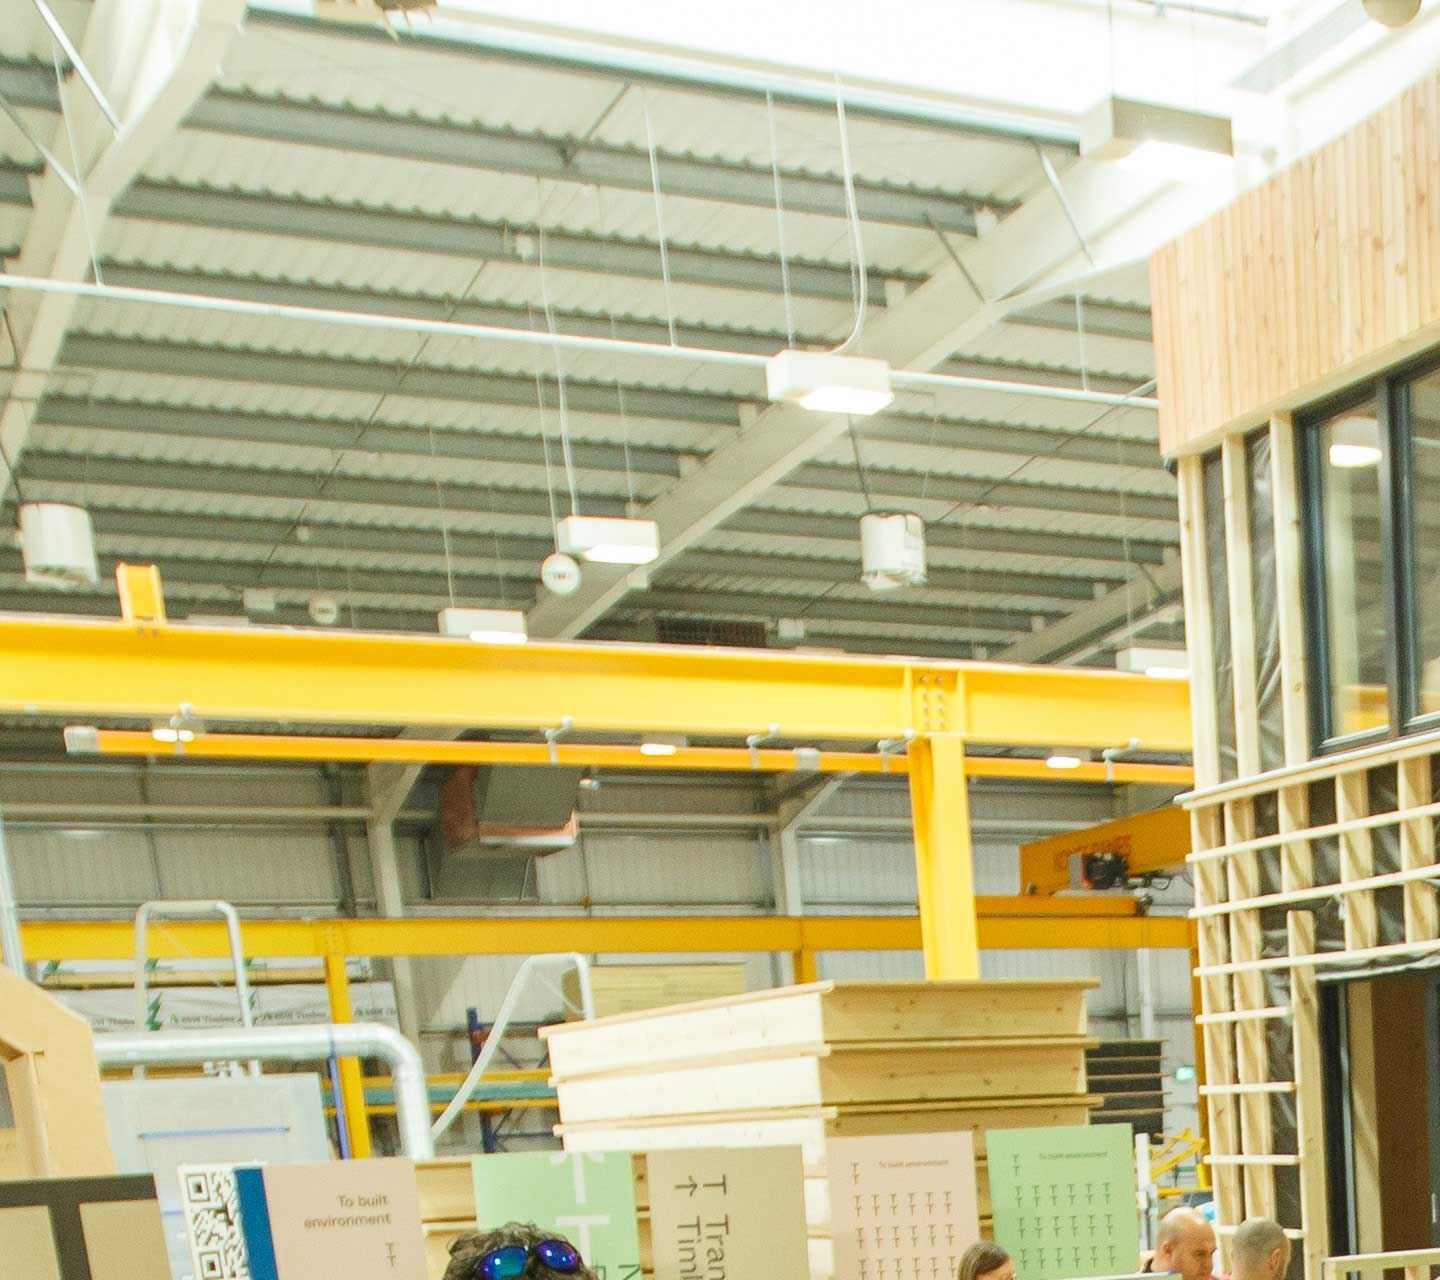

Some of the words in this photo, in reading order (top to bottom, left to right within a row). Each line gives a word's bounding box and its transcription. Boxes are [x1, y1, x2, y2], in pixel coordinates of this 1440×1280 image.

[338, 1195, 353, 1209] To
[358, 1193, 388, 1208] built
[304, 1212, 391, 1229] environment
